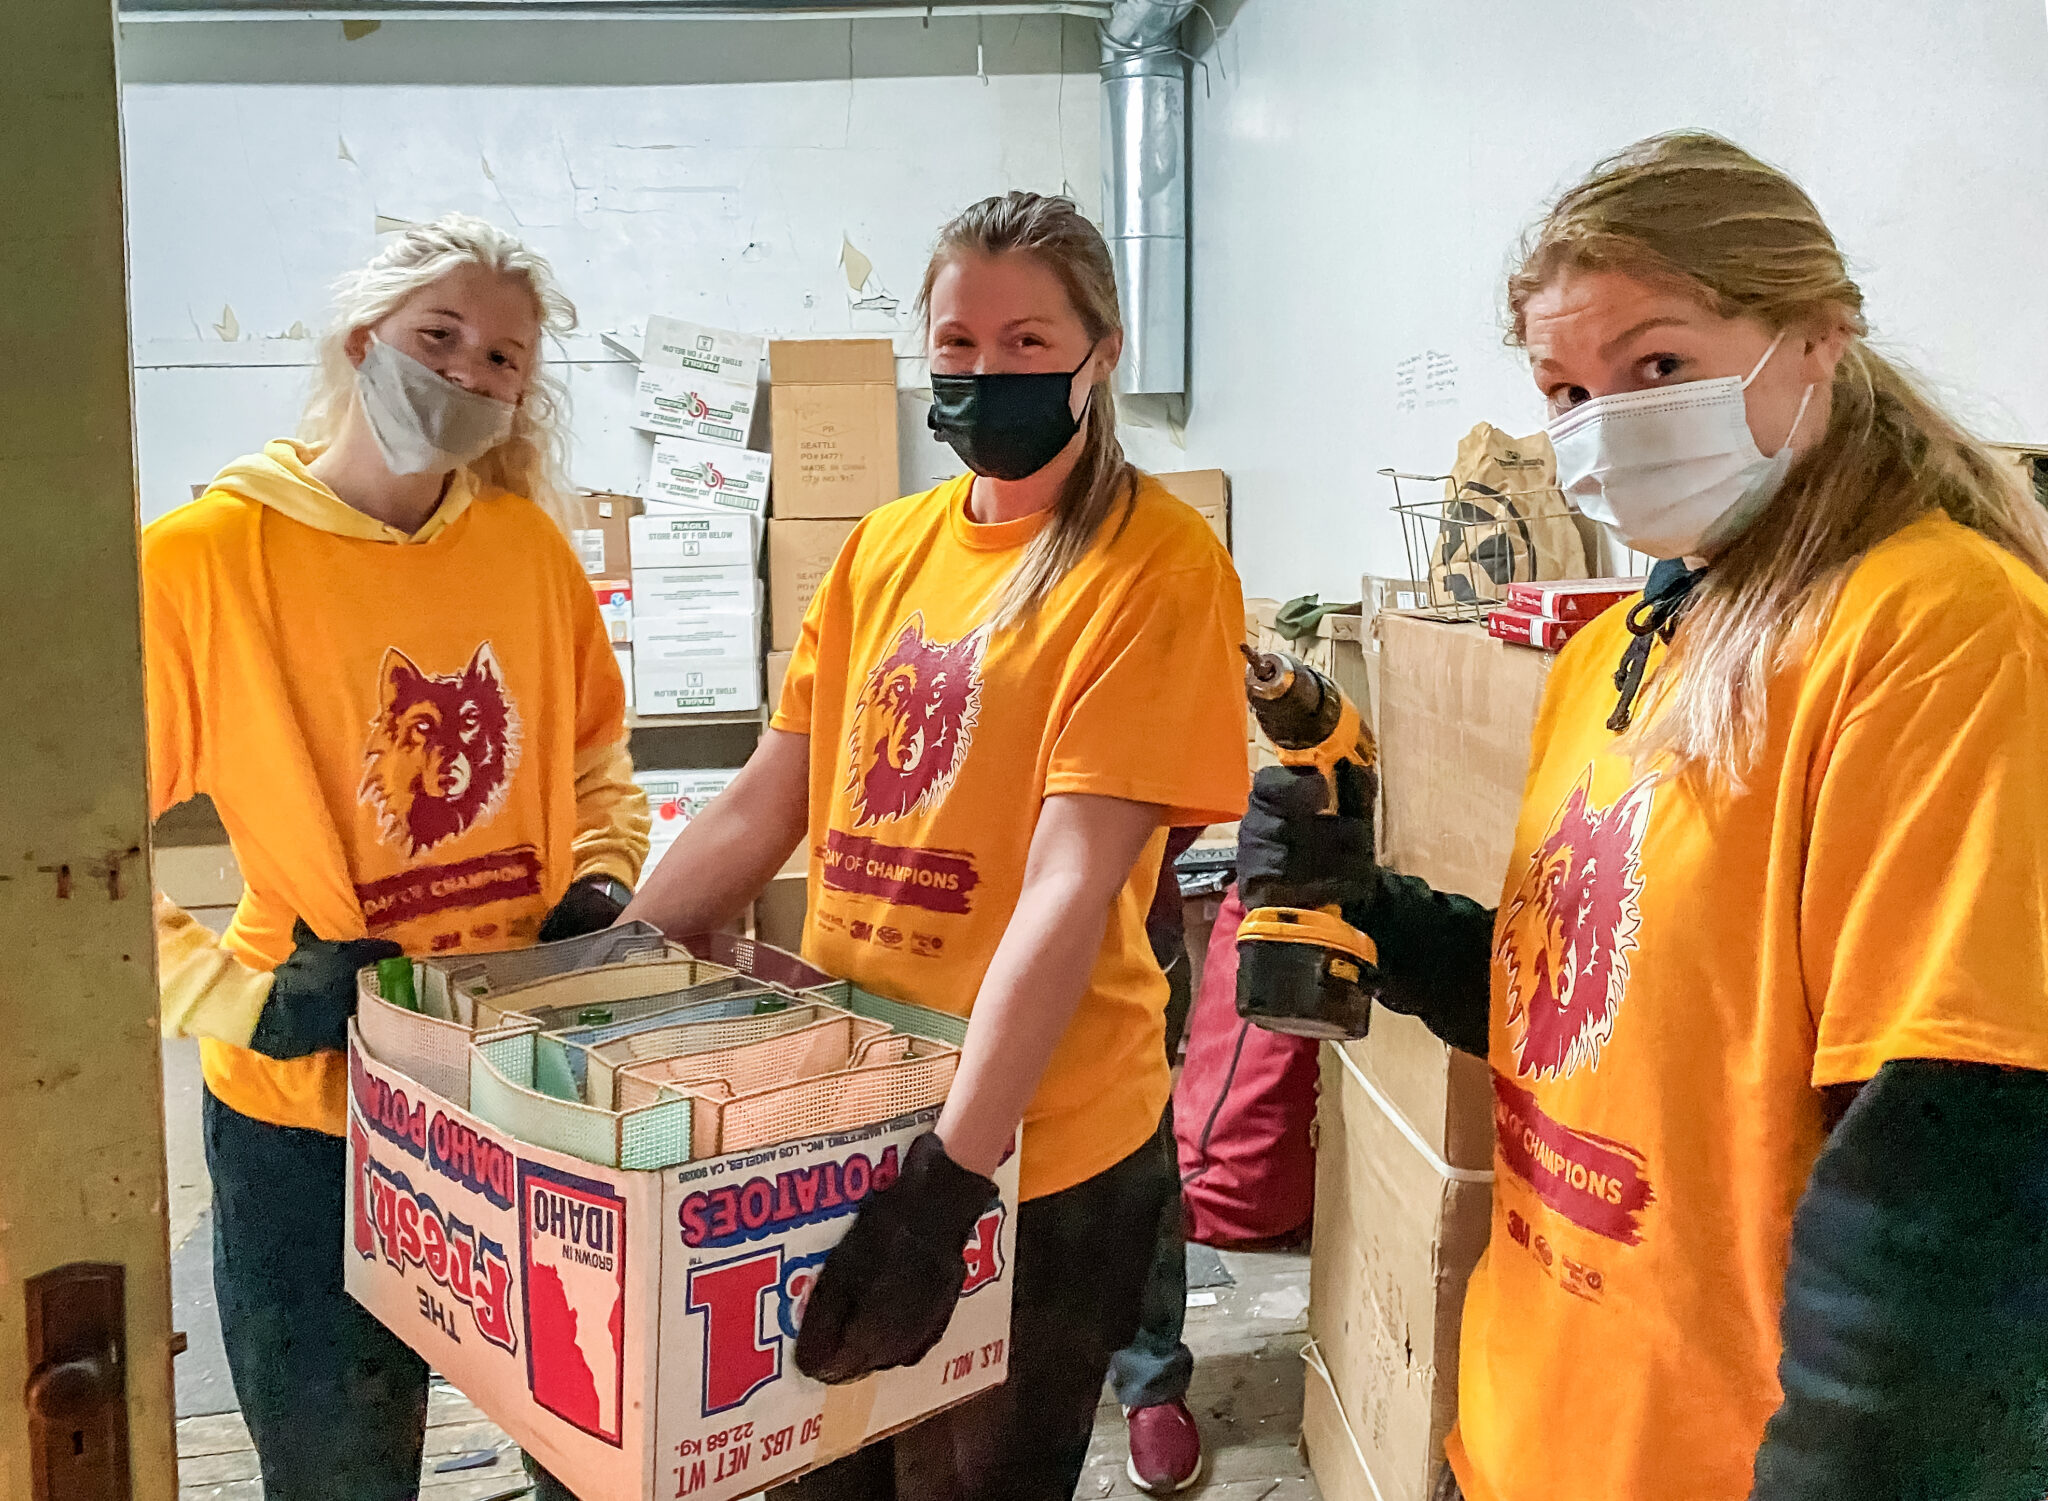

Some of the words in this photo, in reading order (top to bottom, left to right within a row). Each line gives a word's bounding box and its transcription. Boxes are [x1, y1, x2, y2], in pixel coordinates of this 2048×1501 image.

[662, 345, 686, 355] BELOW
[687, 350, 697, 358] OR
[683, 358, 718, 372] FRAGILE
[722, 357, 743, 367] STORE
[653, 413, 682, 424] STRAIGHT
[683, 419, 694, 427] CUT
[670, 483, 698, 493] STRAIGHT
[673, 522, 708, 530] FRAGILE
[709, 531, 733, 539] BELOW
[654, 688, 677, 697] BELOW
[679, 698, 714, 706] FRAGILE
[715, 687, 737, 695] STORE
[824, 849, 843, 867] DAY
[845, 855, 863, 872] OF
[866, 859, 959, 891] CHAMPIONS
[429, 1111, 514, 1208] IDAHO
[778, 1145, 801, 1159] LOS
[711, 1163, 725, 1177] CA
[1523, 1127, 1623, 1205] CHAMPIONS
[679, 1145, 898, 1246] POTATOES
[534, 1190, 614, 1255] IDAHO
[562, 1244, 575, 1260] IN
[577, 1248, 614, 1272] GROWN
[417, 1285, 461, 1344] THE
[686, 1244, 783, 1417] 1
[981, 1338, 1004, 1369] U.S.
[707, 1420, 754, 1451] 22.68
[799, 1413, 823, 1446] 50
[674, 1435, 702, 1458] kg.
[760, 1425, 794, 1461] LBS.
[714, 1443, 751, 1484] NET
[673, 1458, 707, 1498] WT.
